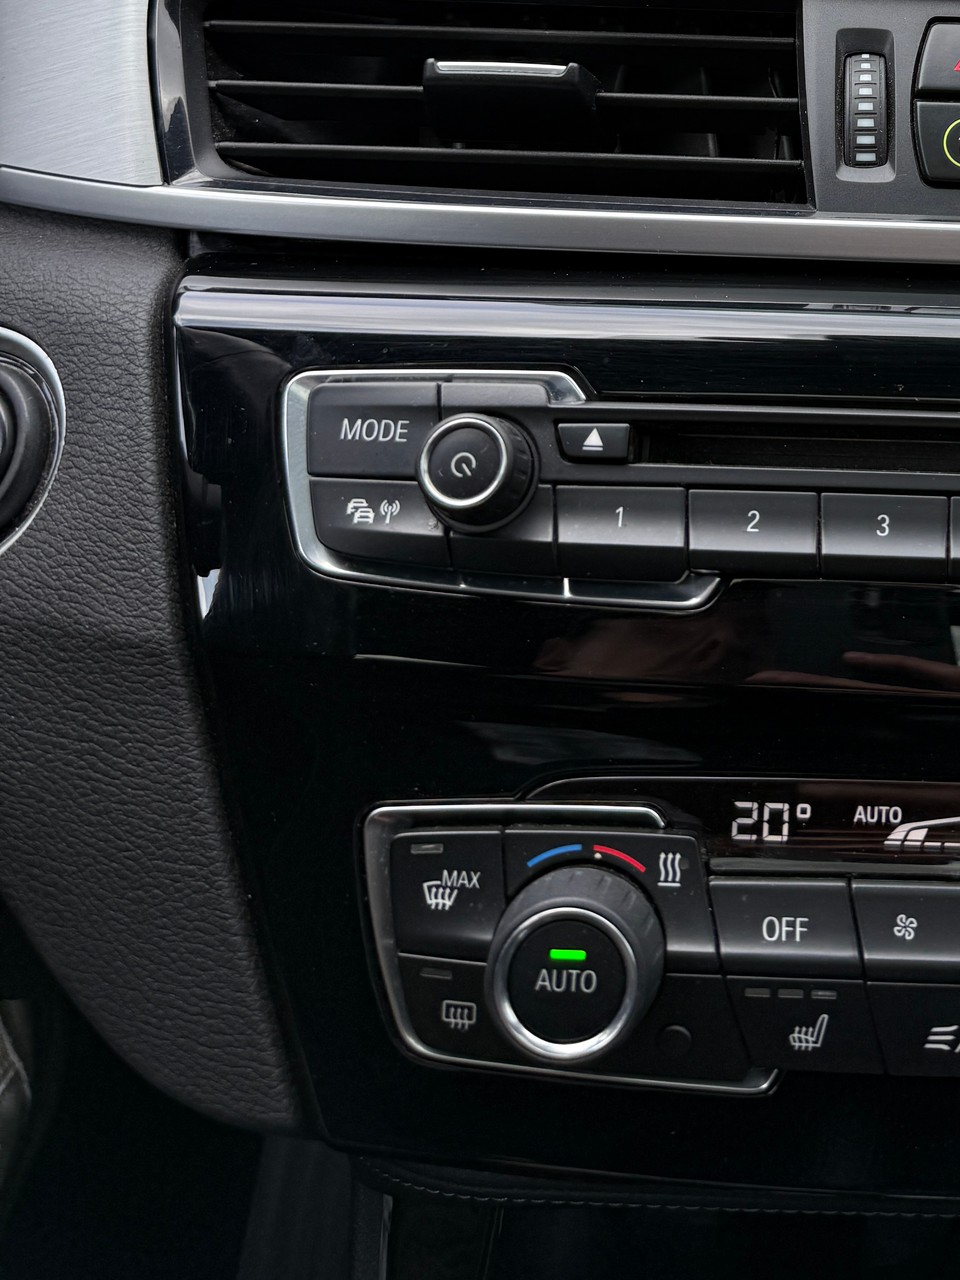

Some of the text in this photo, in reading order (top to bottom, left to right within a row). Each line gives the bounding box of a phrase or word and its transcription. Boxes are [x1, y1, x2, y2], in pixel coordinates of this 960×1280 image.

[340, 419, 409, 443] MODE
[615, 507, 624, 527] 1
[746, 510, 760, 533] 2
[876, 514, 890, 536] 3
[854, 805, 902, 824] AUTO
[442, 870, 480, 889] MAX
[762, 917, 808, 941] OFF
[535, 969, 596, 993] AUTO
